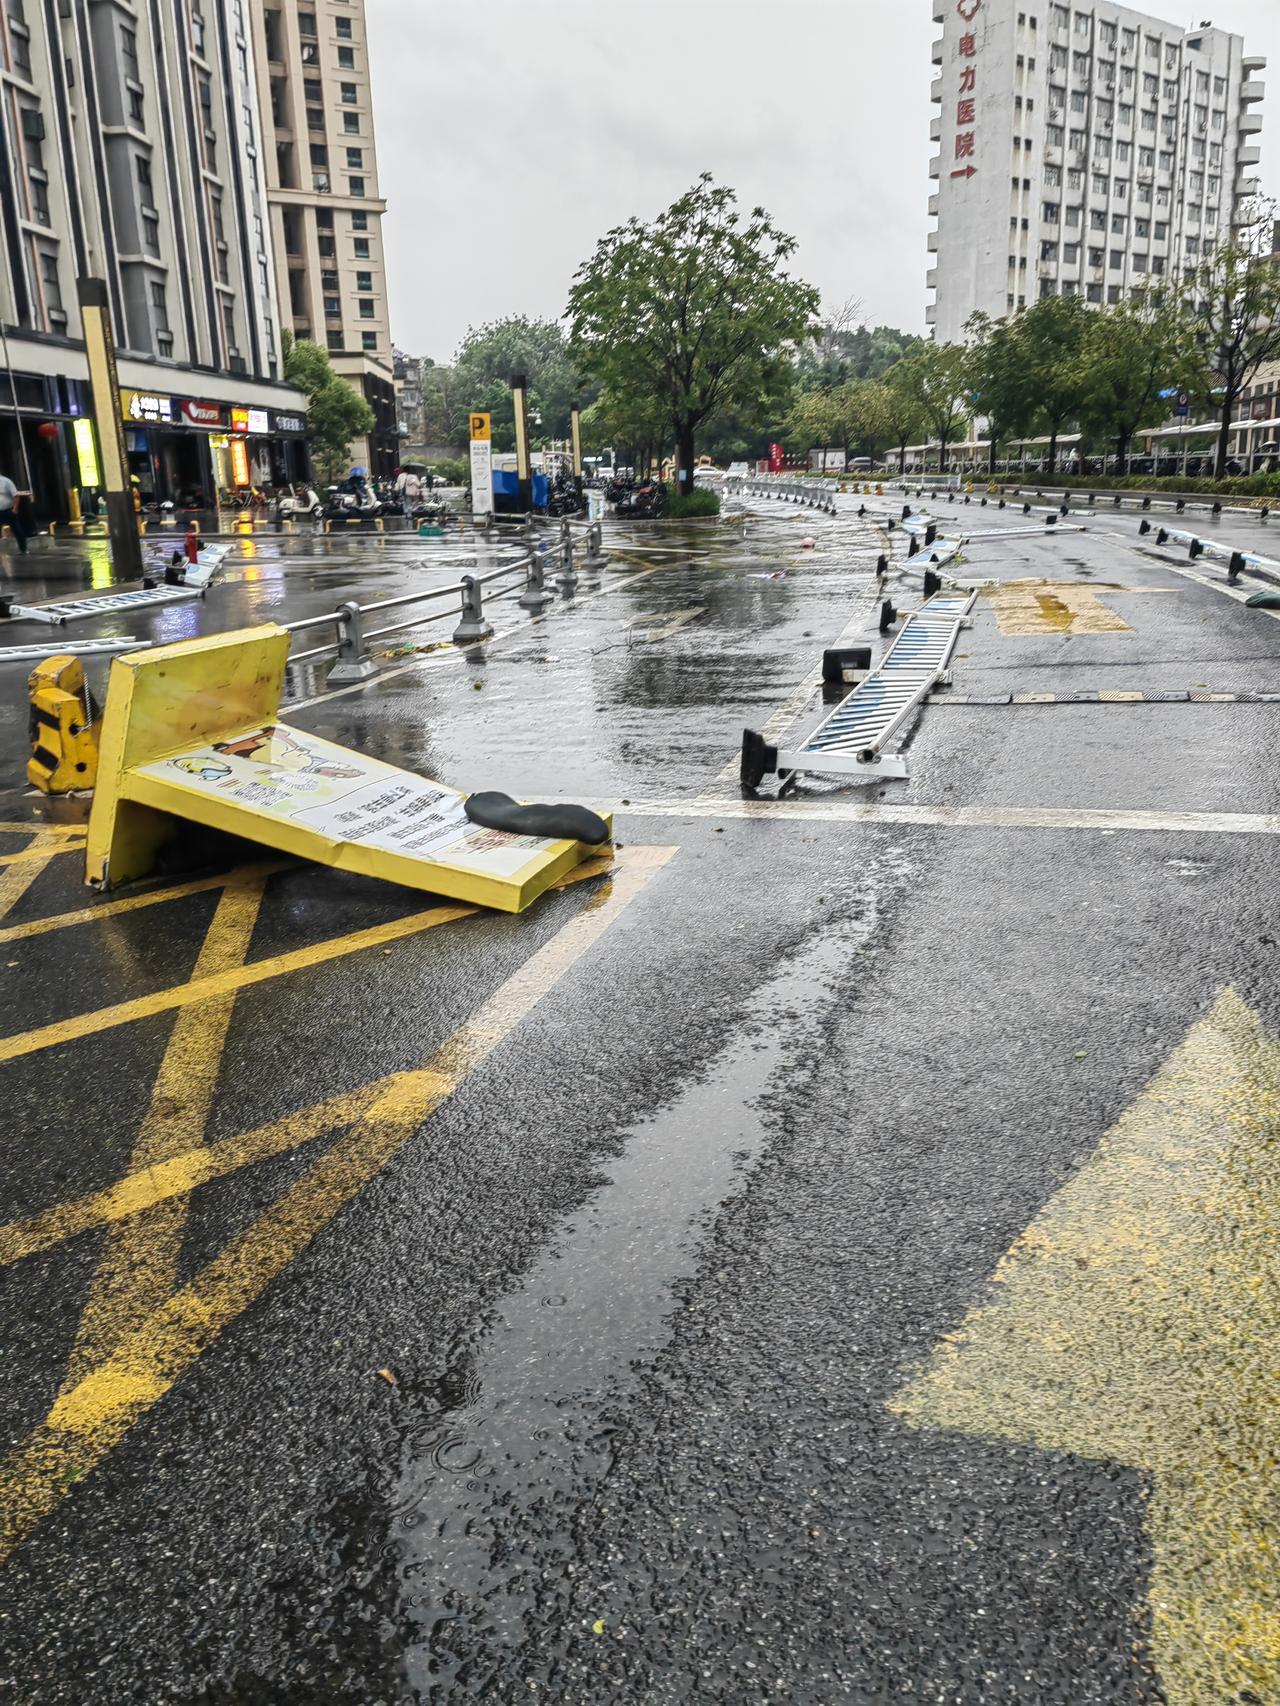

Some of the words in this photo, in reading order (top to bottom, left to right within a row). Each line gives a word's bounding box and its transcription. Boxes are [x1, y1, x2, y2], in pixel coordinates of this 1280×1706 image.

[955, 32, 976, 160] 电力医院
[472, 417, 485, 438] P
